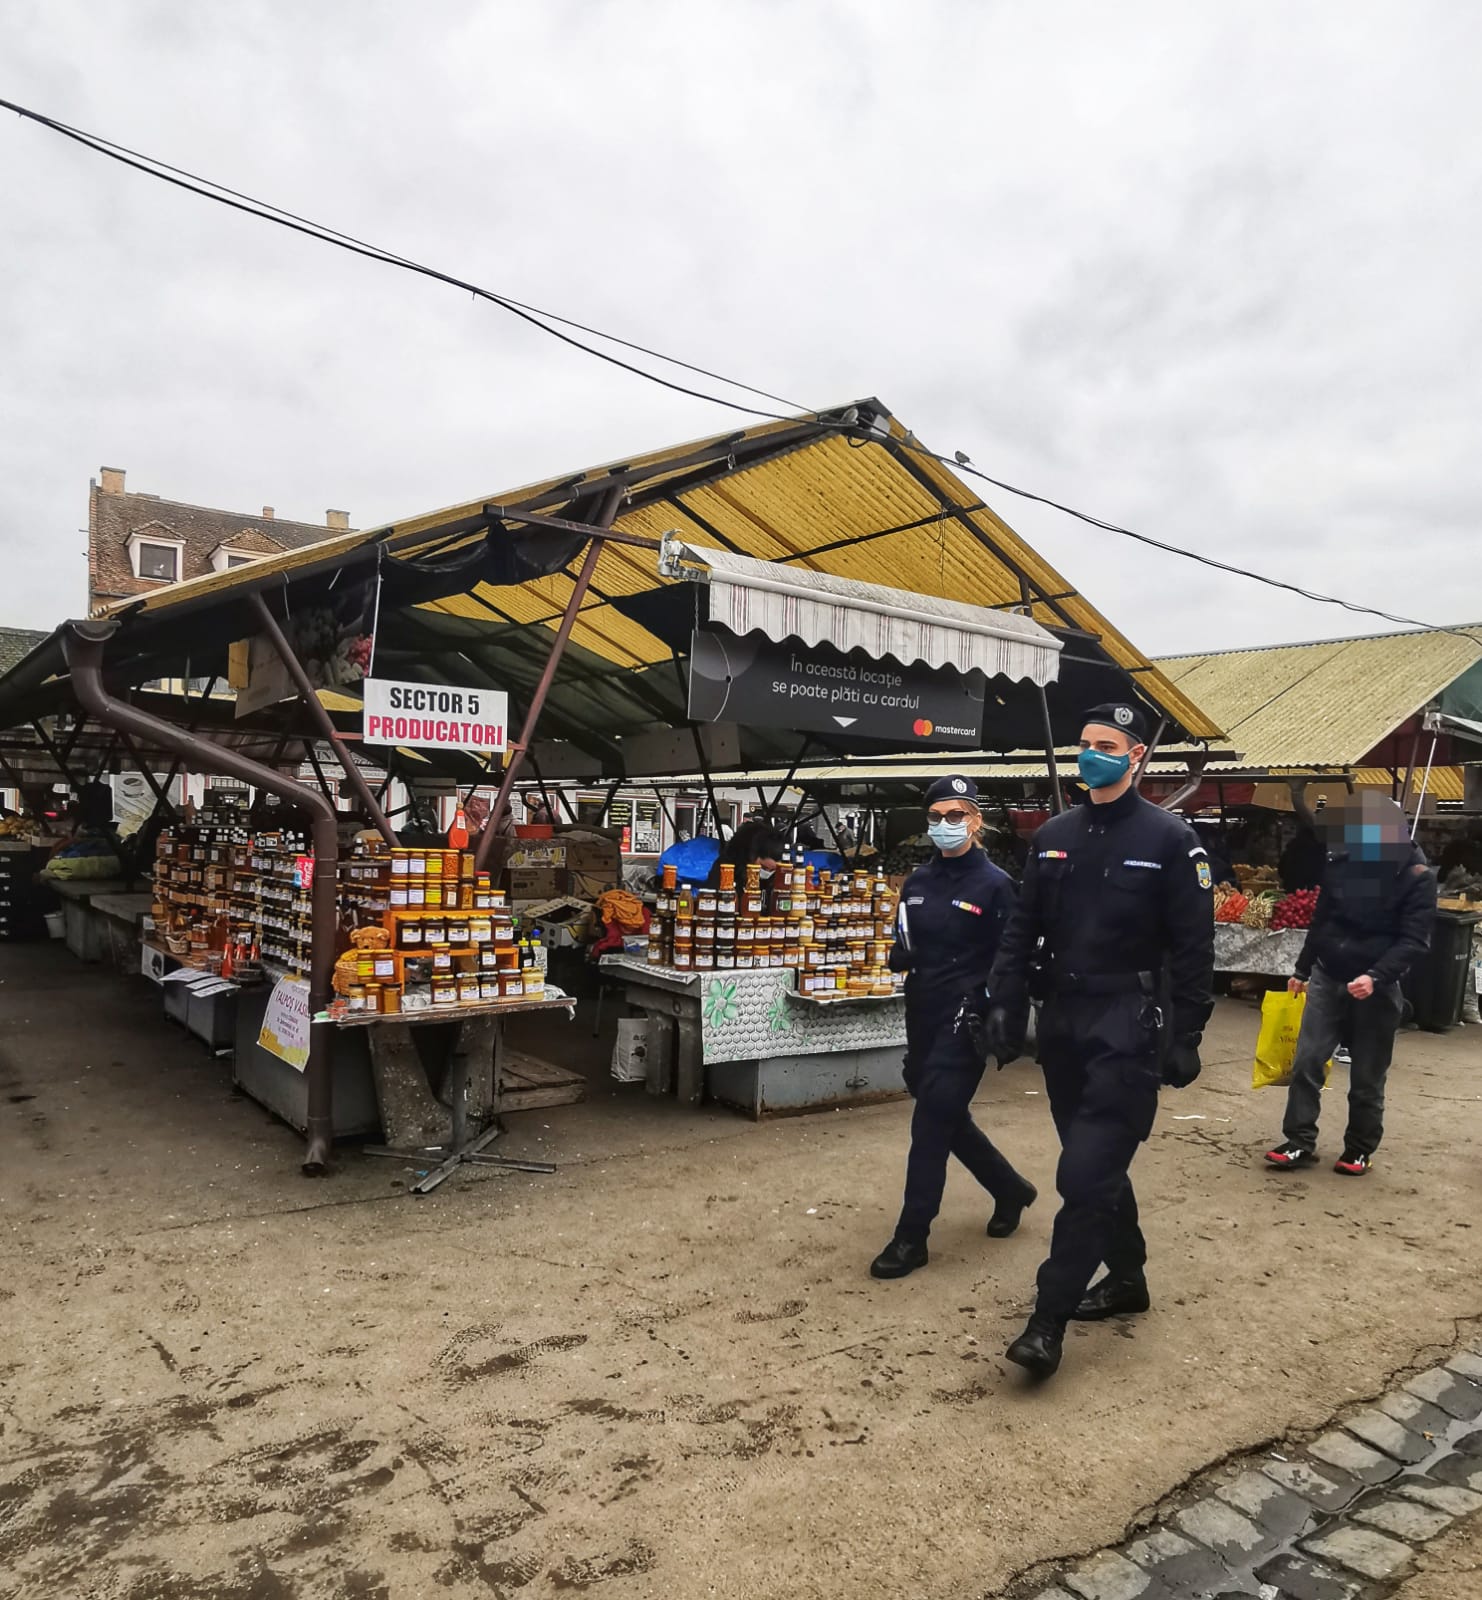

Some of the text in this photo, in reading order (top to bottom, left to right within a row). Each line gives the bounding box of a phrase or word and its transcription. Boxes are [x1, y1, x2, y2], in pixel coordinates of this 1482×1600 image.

[806, 663, 857, 680] această
[390, 687, 480, 715] SECTOR 5
[772, 681, 920, 709] se poate plăti cu cardul
[369, 715, 503, 746] PRODUCATORI
[935, 725, 976, 737] mastercard
